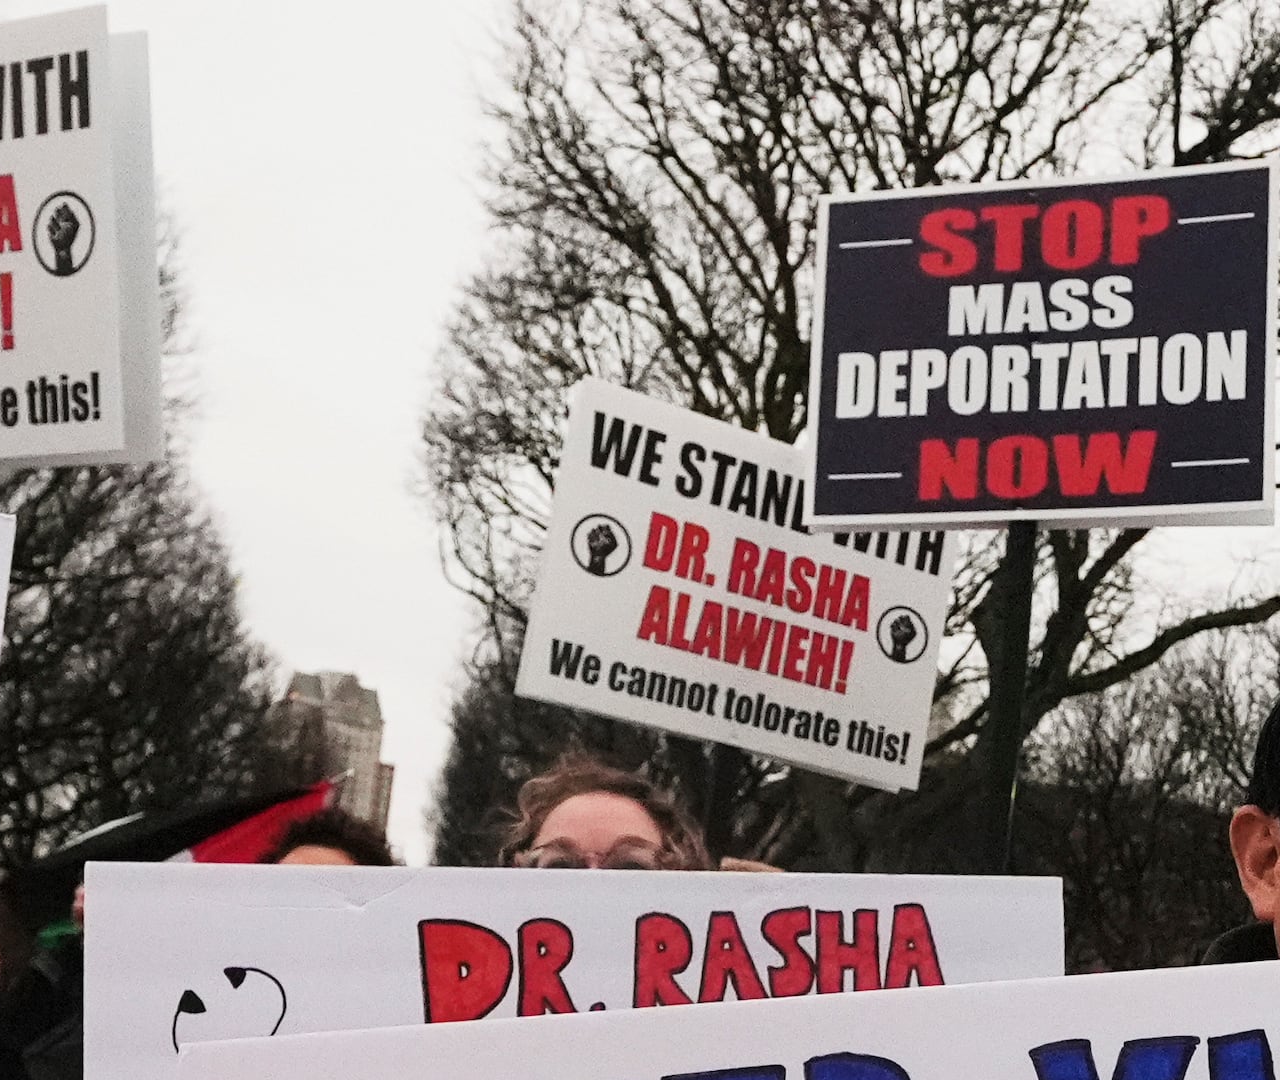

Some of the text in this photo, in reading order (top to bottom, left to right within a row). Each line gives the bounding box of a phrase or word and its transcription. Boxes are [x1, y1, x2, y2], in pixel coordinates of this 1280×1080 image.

[919, 193, 1171, 278] STOP
[947, 274, 1135, 337] MASS
[26, 371, 102, 427] this!
[835, 328, 1249, 420] DEPORTATION
[590, 410, 667, 487] WE
[919, 429, 1159, 501] NOW
[642, 510, 872, 632] DR. RASHA
[636, 584, 856, 695] ALAWIEH!
[549, 638, 912, 765] We cannot tolorate this!
[632, 903, 945, 1009] RASHA
